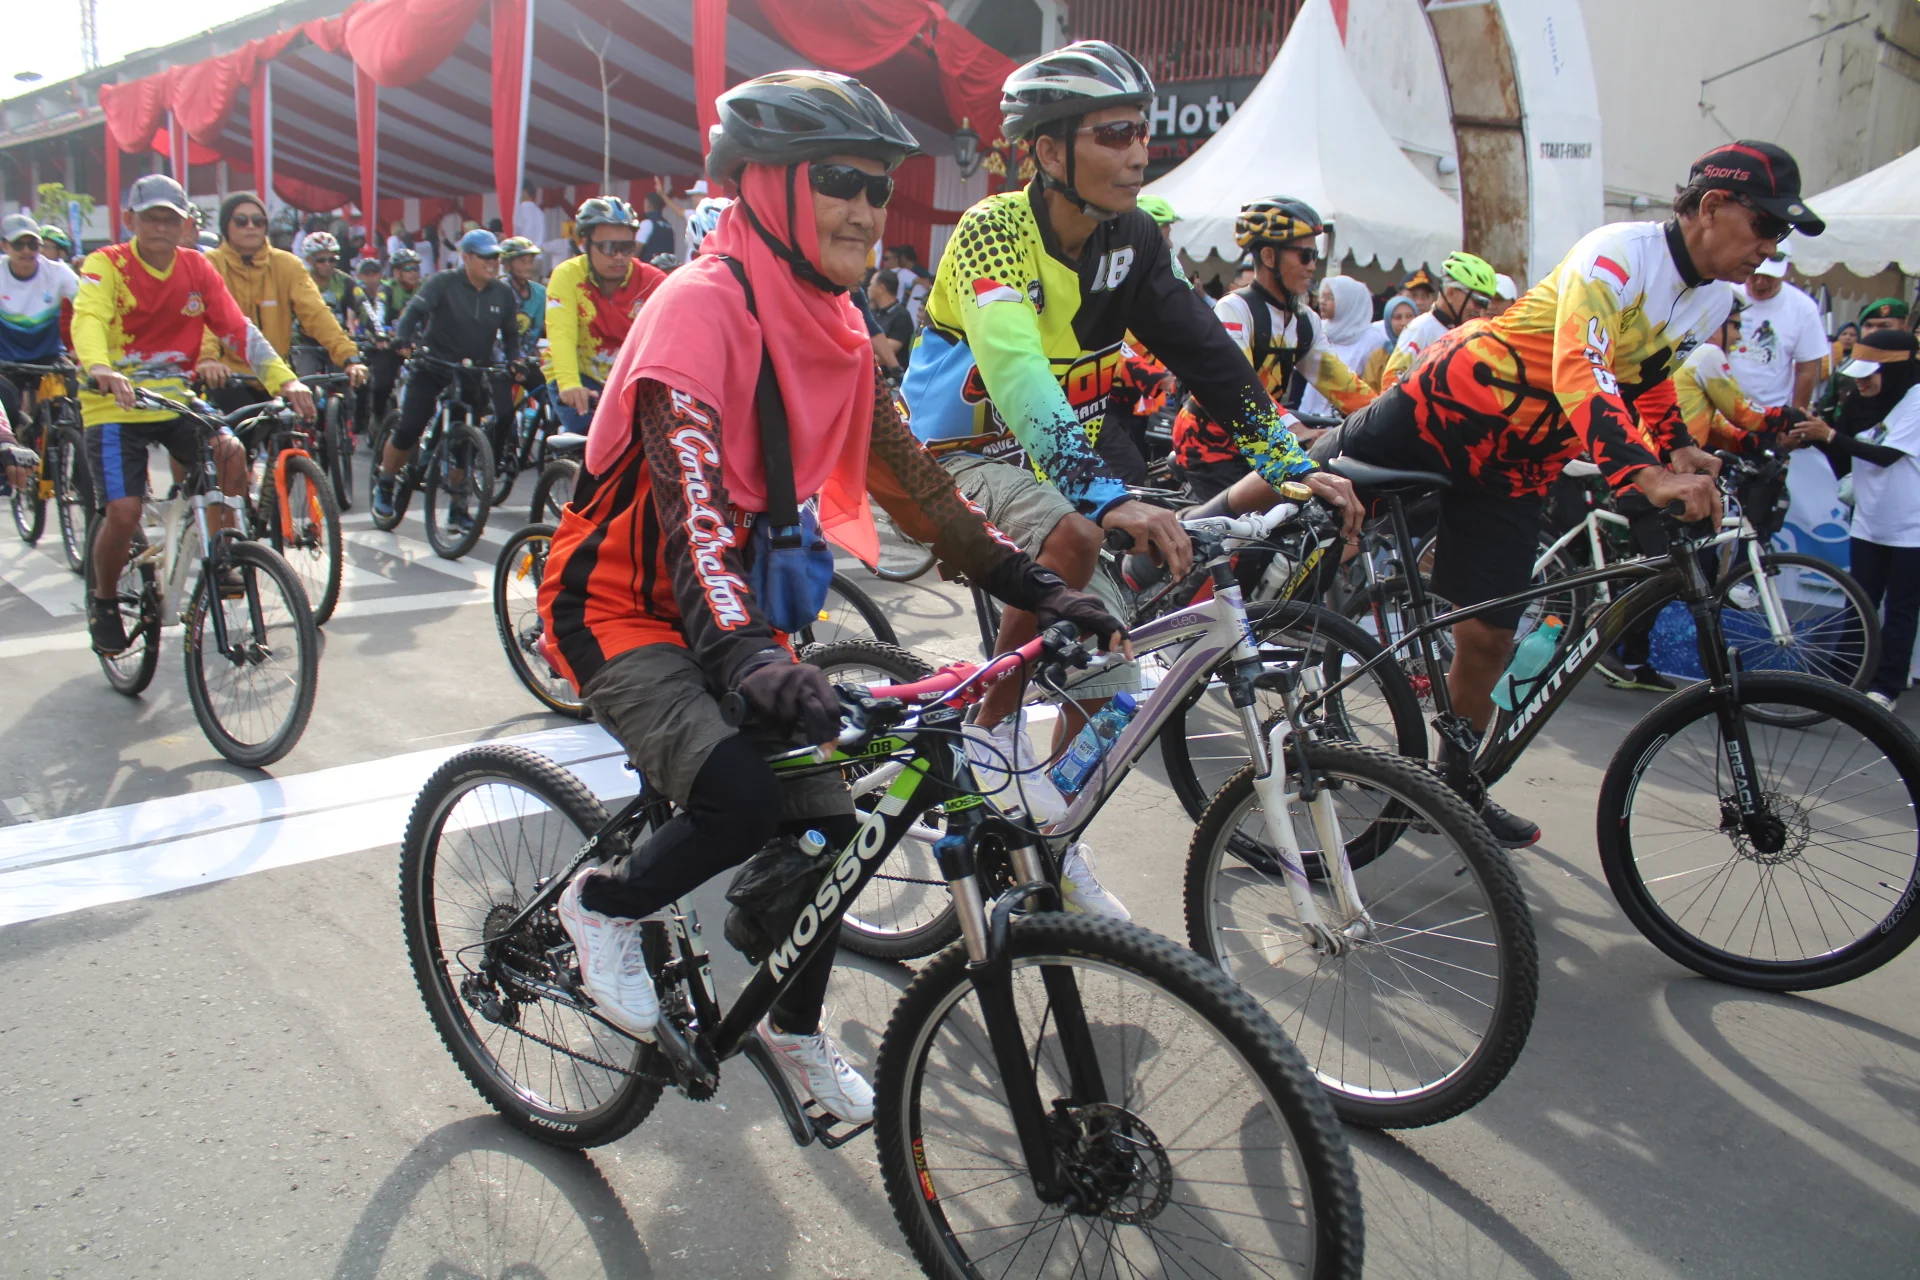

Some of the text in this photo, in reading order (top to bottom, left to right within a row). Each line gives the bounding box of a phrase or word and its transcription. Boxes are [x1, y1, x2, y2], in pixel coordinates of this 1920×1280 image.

[1703, 164, 1751, 181] Sports
[1508, 627, 1600, 742] UNITED
[1726, 740, 1756, 815] BREACH
[567, 835, 598, 872] MOSSO
[768, 813, 886, 984] MOSSO
[528, 1113, 578, 1133] KENDA
